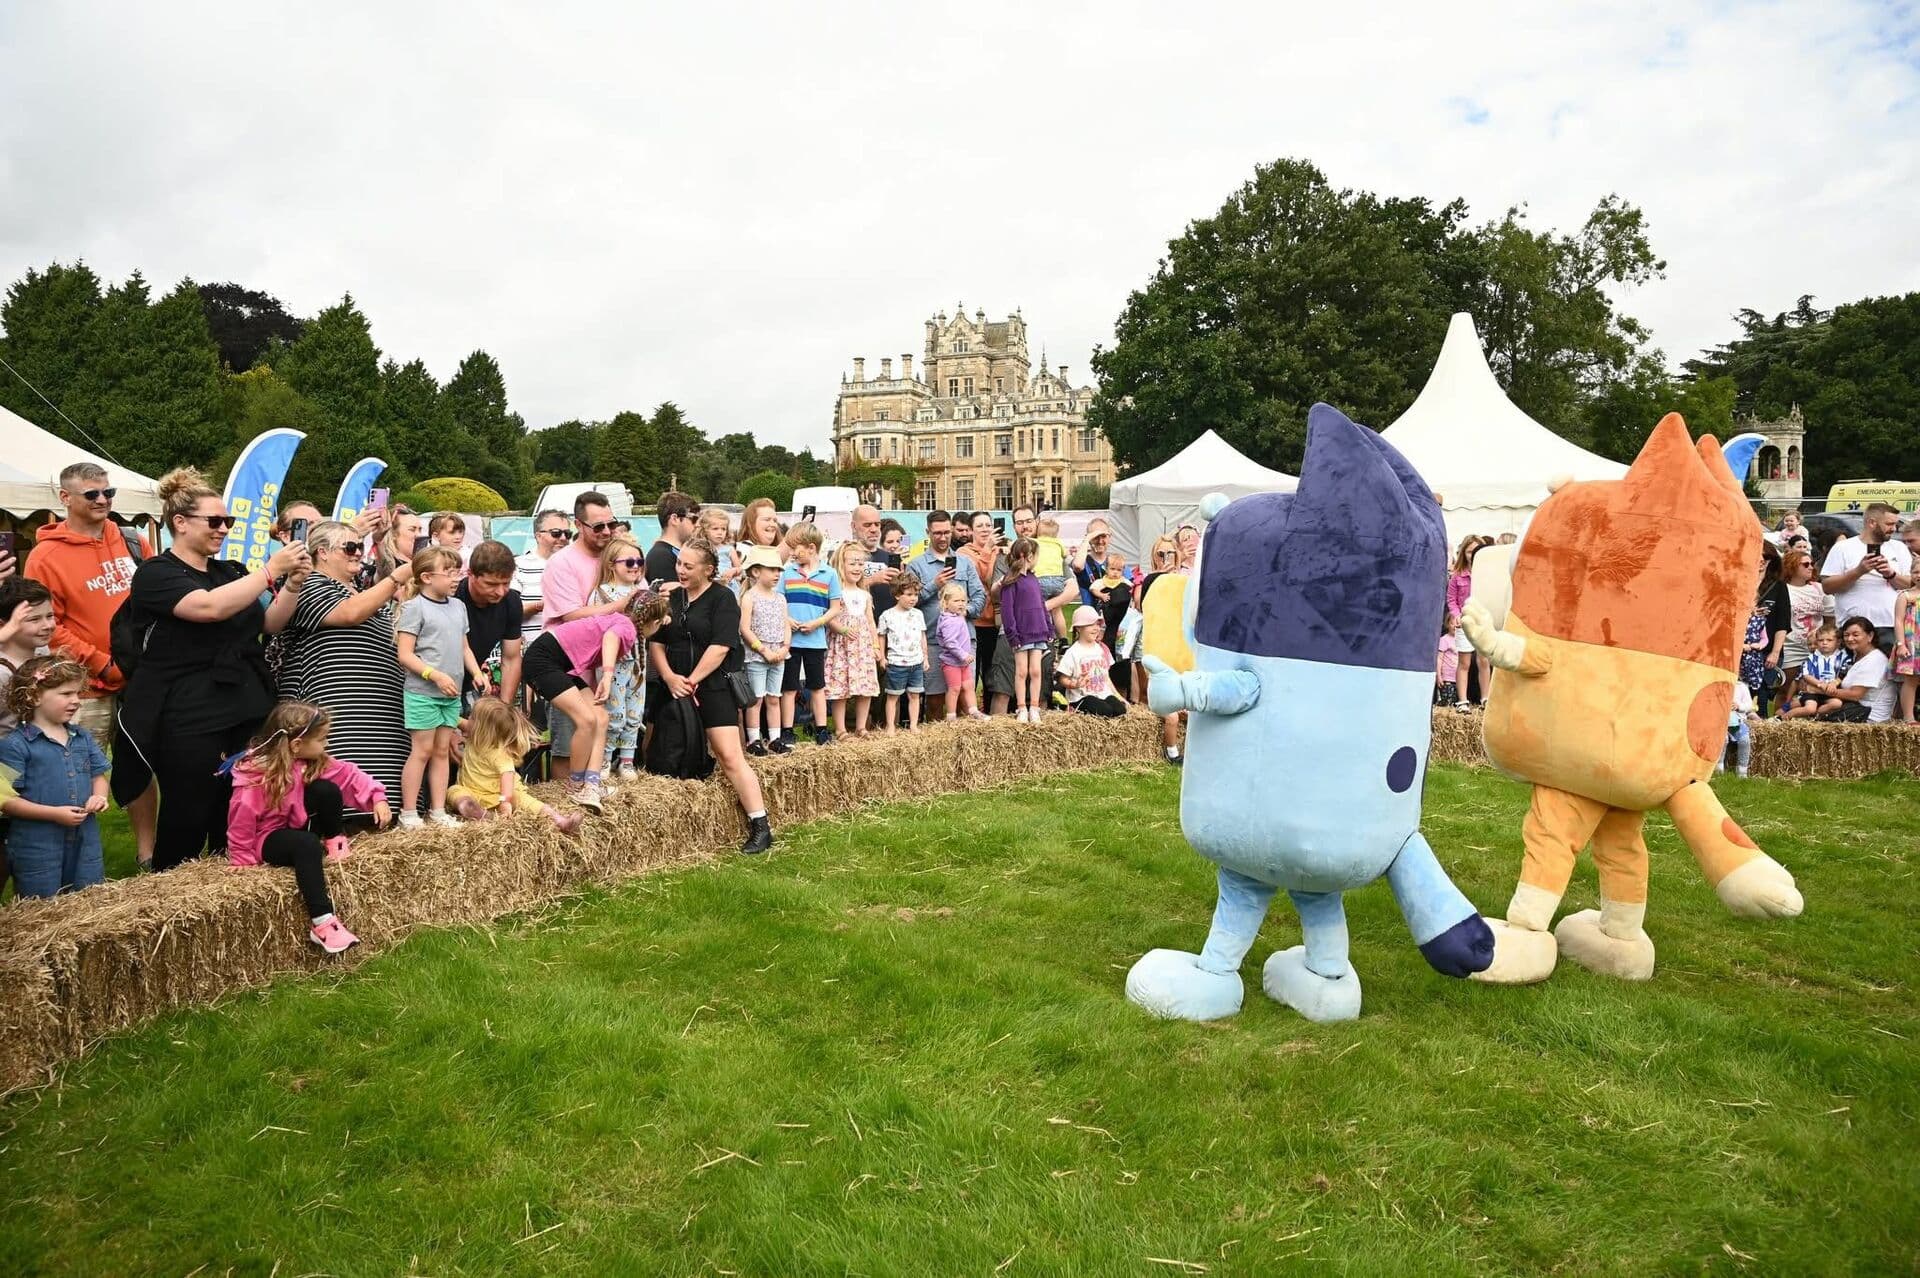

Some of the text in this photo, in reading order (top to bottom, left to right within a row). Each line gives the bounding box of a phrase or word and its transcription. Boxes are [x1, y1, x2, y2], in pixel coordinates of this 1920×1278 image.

[228, 499, 250, 561] BBC
[246, 482, 278, 573] Beebies
[87, 567, 131, 591] NORTH
[101, 558, 126, 574] THE
